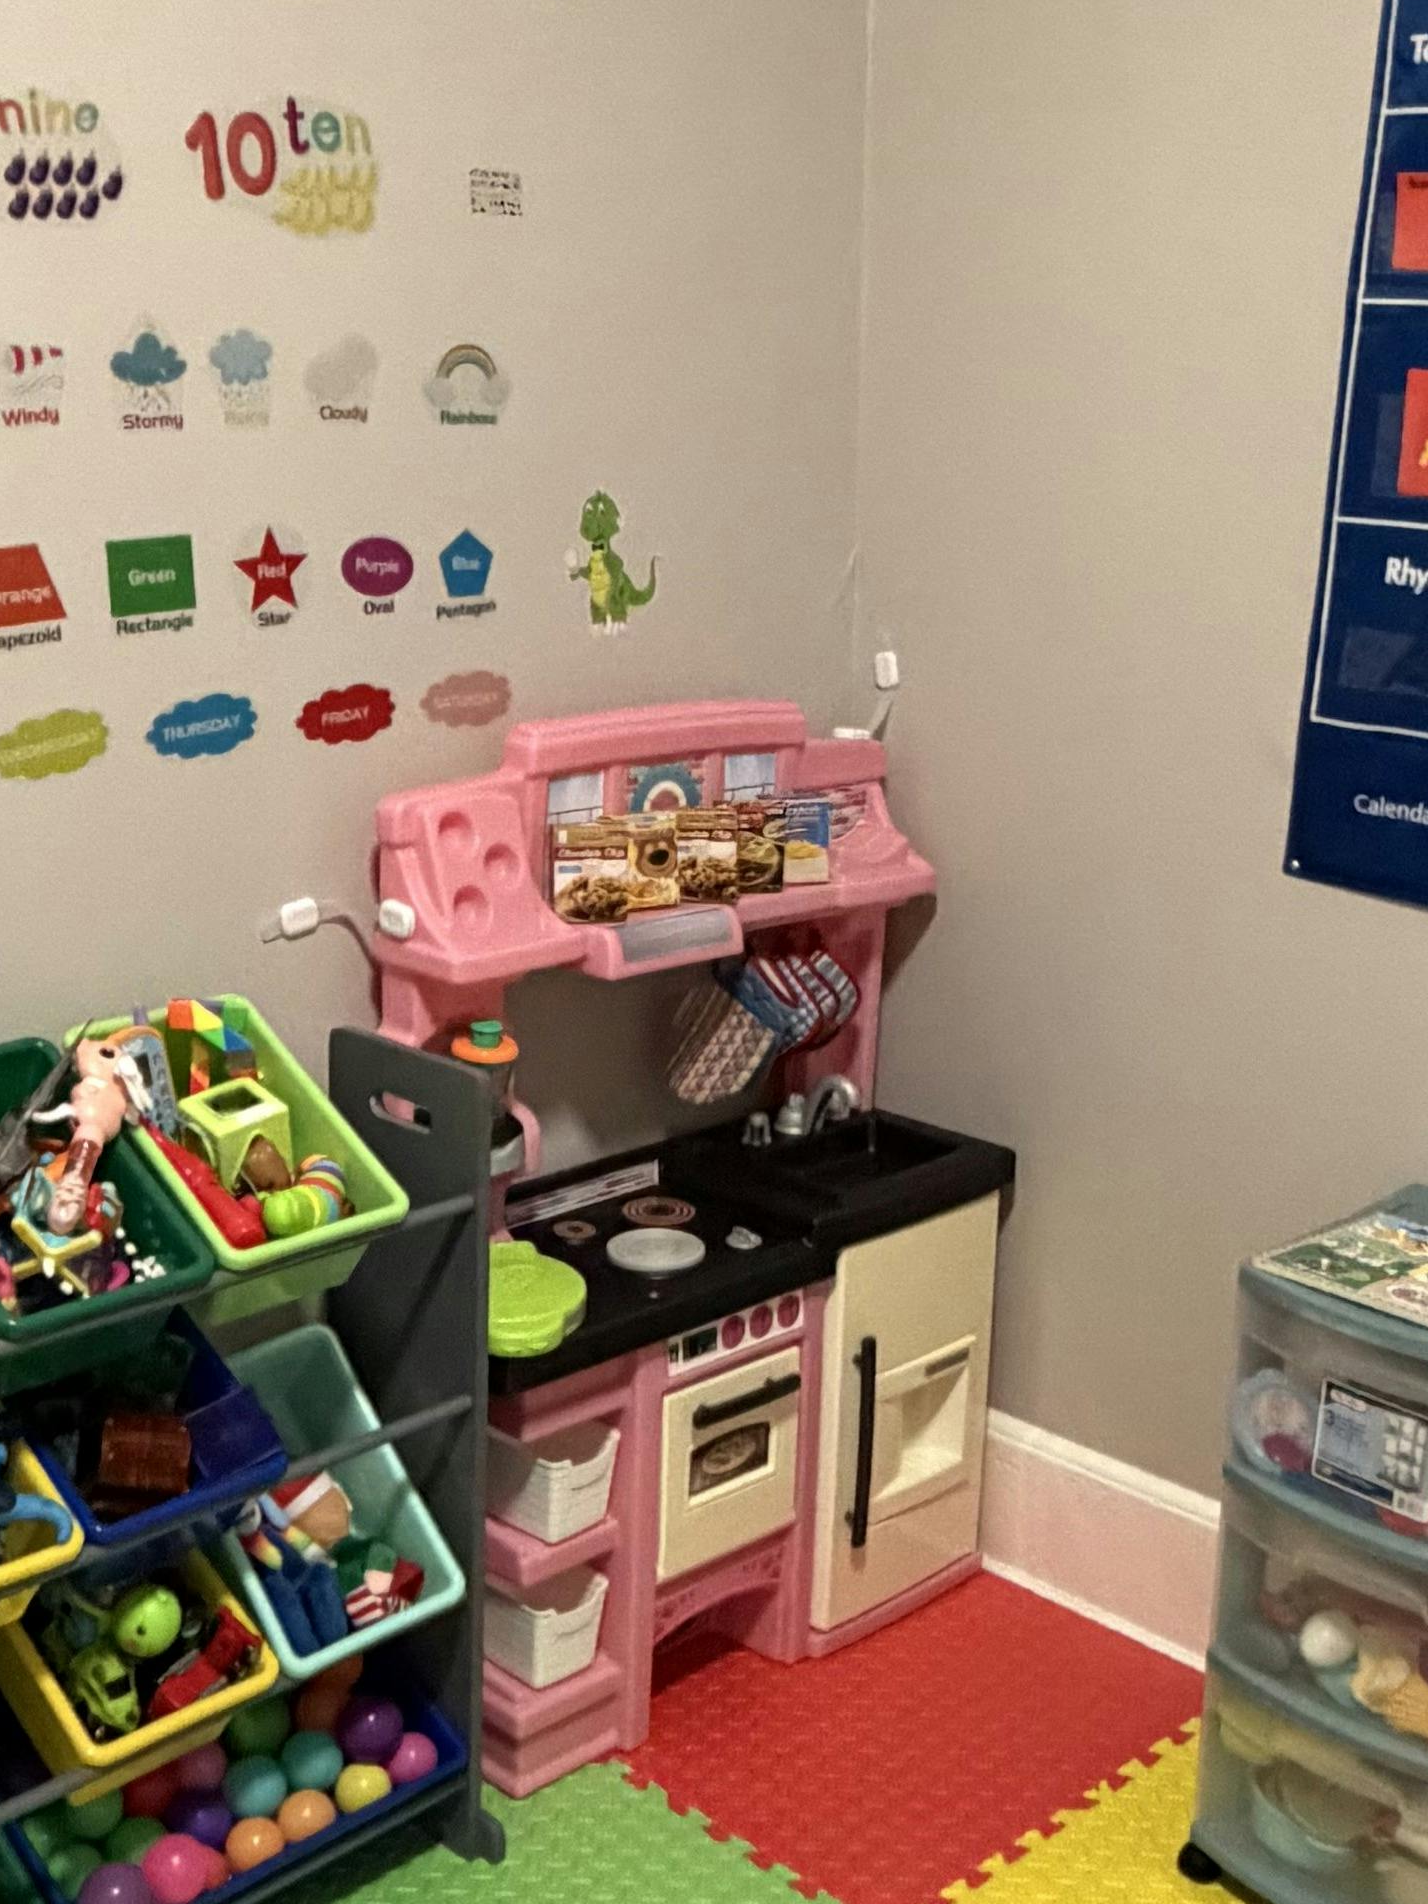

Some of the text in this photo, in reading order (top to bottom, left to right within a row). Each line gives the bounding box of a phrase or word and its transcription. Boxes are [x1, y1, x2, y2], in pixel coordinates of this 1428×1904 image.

[184, 95, 372, 201] 10 ten
[1, 405, 61, 428] Windy
[122, 411, 185, 432] Stormy
[256, 561, 286, 581] Red
[354, 554, 402, 576] Purple
[127, 567, 177, 587] Green
[362, 599, 395, 616] Oval
[115, 613, 195, 637] Rectangle
[257, 610, 292, 628] Star
[320, 704, 371, 728] FRIDAY
[162, 713, 242, 744] THURSDAY
